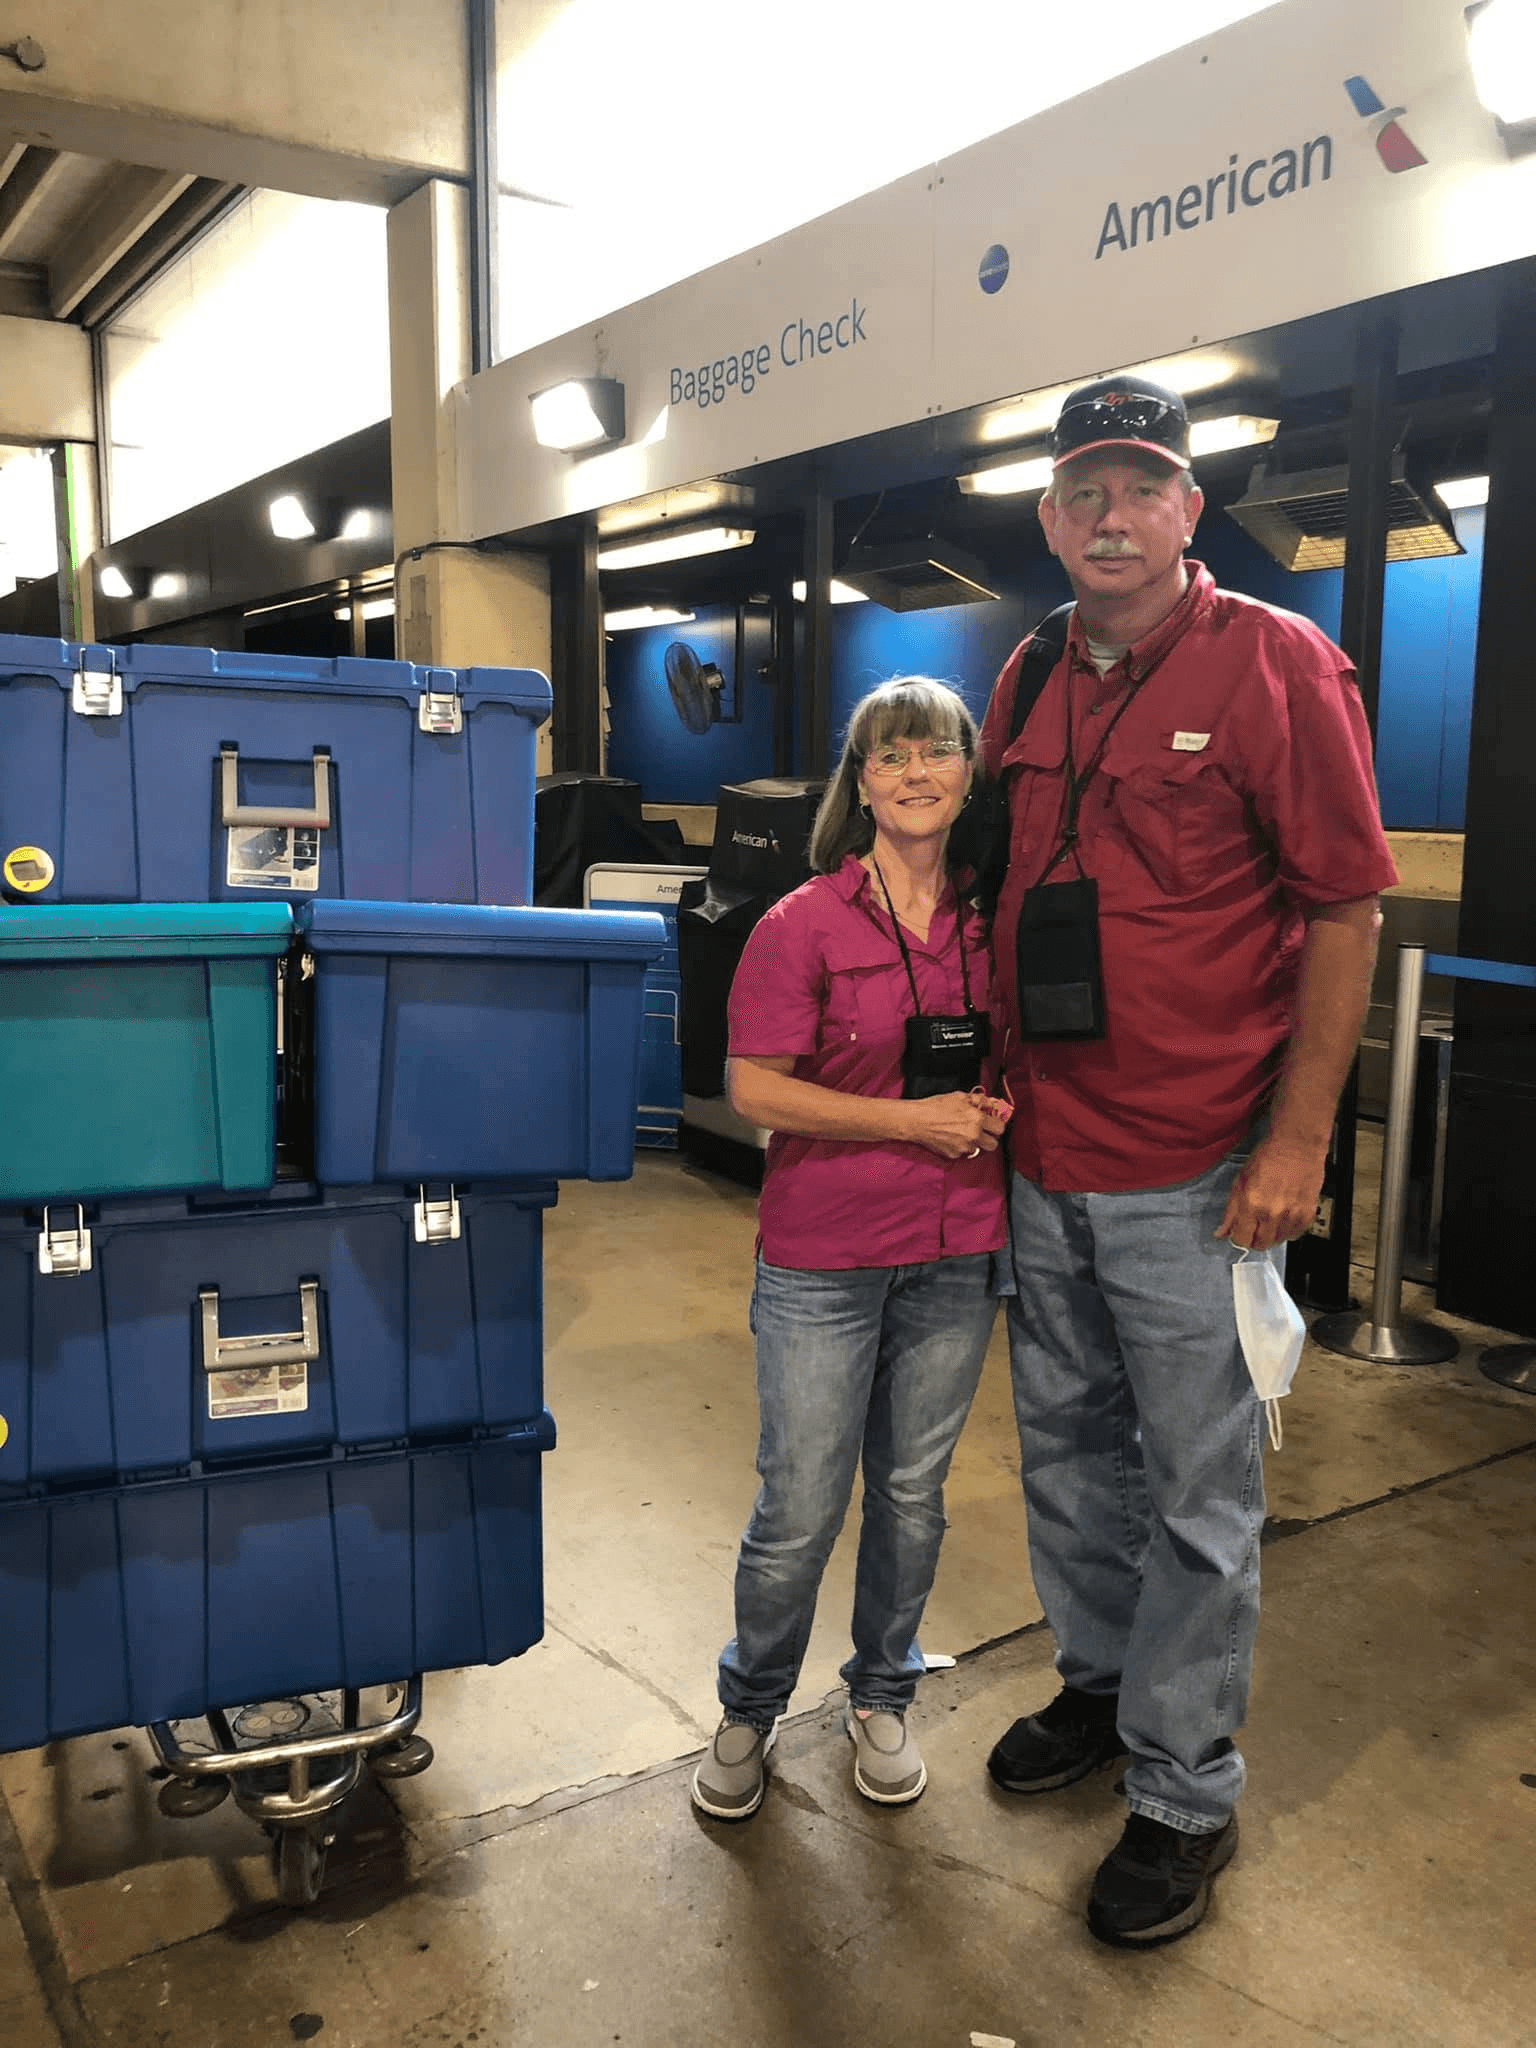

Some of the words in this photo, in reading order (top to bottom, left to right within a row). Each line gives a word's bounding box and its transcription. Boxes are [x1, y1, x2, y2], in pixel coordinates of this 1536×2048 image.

[1094, 134, 1332, 260] American
[669, 343, 771, 409] Baggage
[780, 297, 867, 367] Check
[732, 830, 767, 848] American
